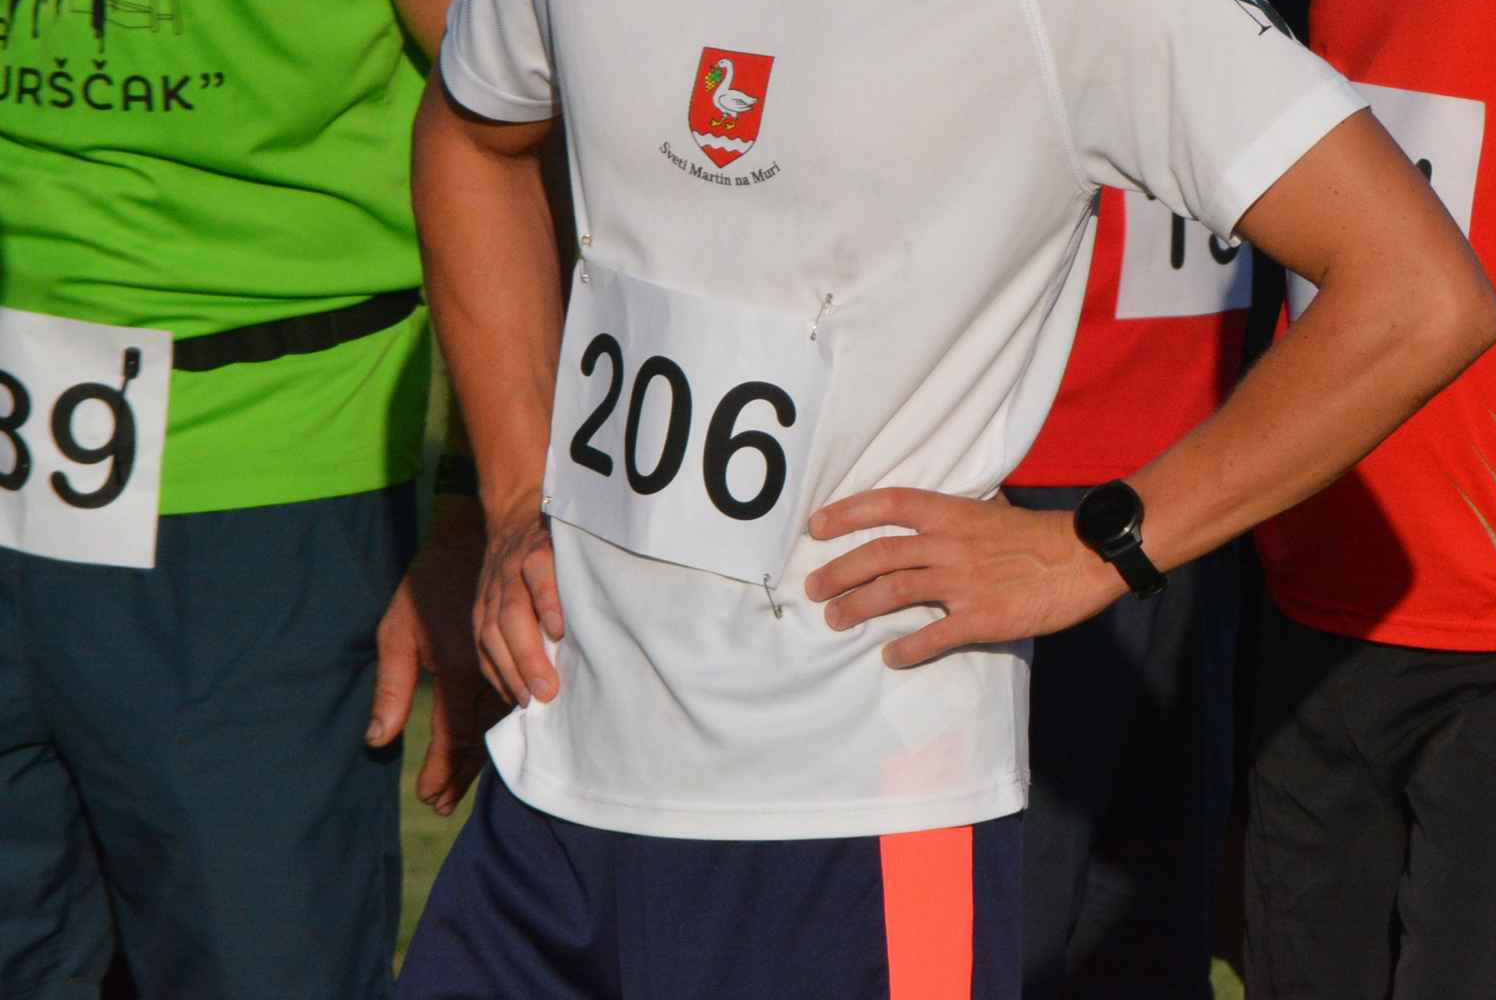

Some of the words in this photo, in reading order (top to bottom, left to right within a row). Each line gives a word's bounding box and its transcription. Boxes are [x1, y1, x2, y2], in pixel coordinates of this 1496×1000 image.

[660, 141, 687, 170] Sveti
[690, 165, 732, 186] Martin
[735, 175, 750, 186] na
[751, 161, 781, 184] Muri
[570, 332, 797, 521] 206
